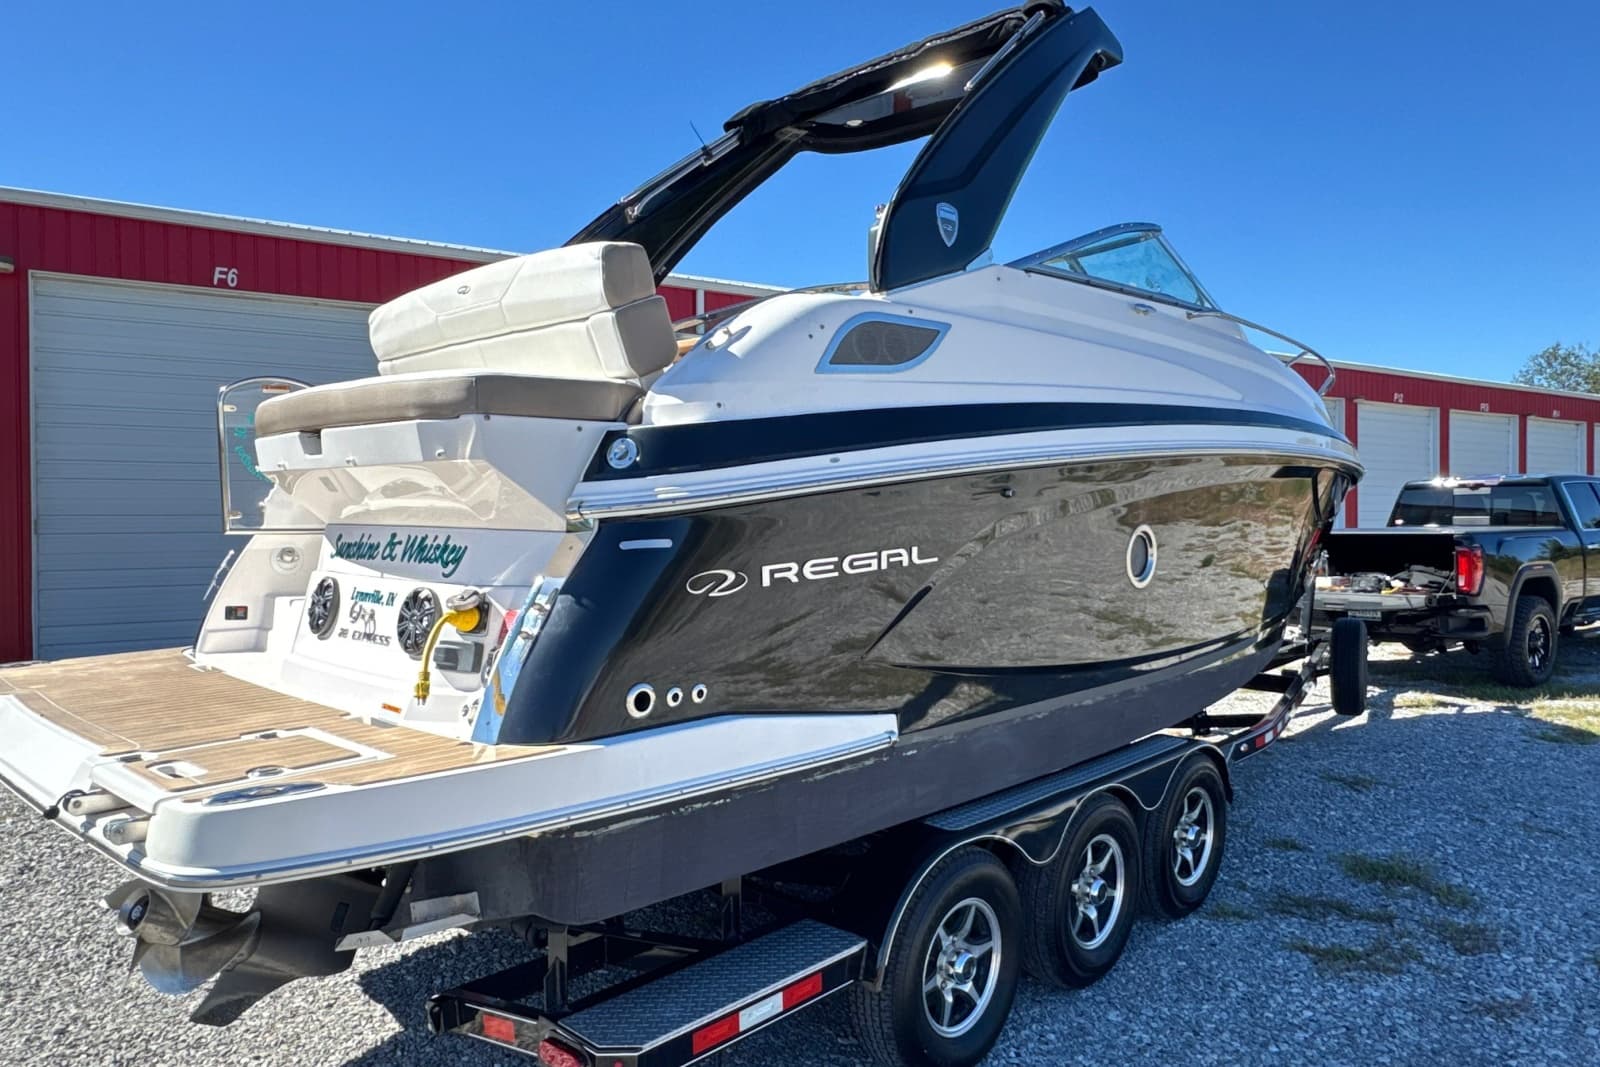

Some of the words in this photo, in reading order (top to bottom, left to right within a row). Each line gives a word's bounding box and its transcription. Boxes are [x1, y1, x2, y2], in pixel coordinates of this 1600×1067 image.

[213, 266, 239, 288] F6
[330, 533, 381, 560] Sunshine
[381, 532, 403, 562] &
[400, 533, 468, 578] Whiskey
[761, 546, 939, 588] REGAL
